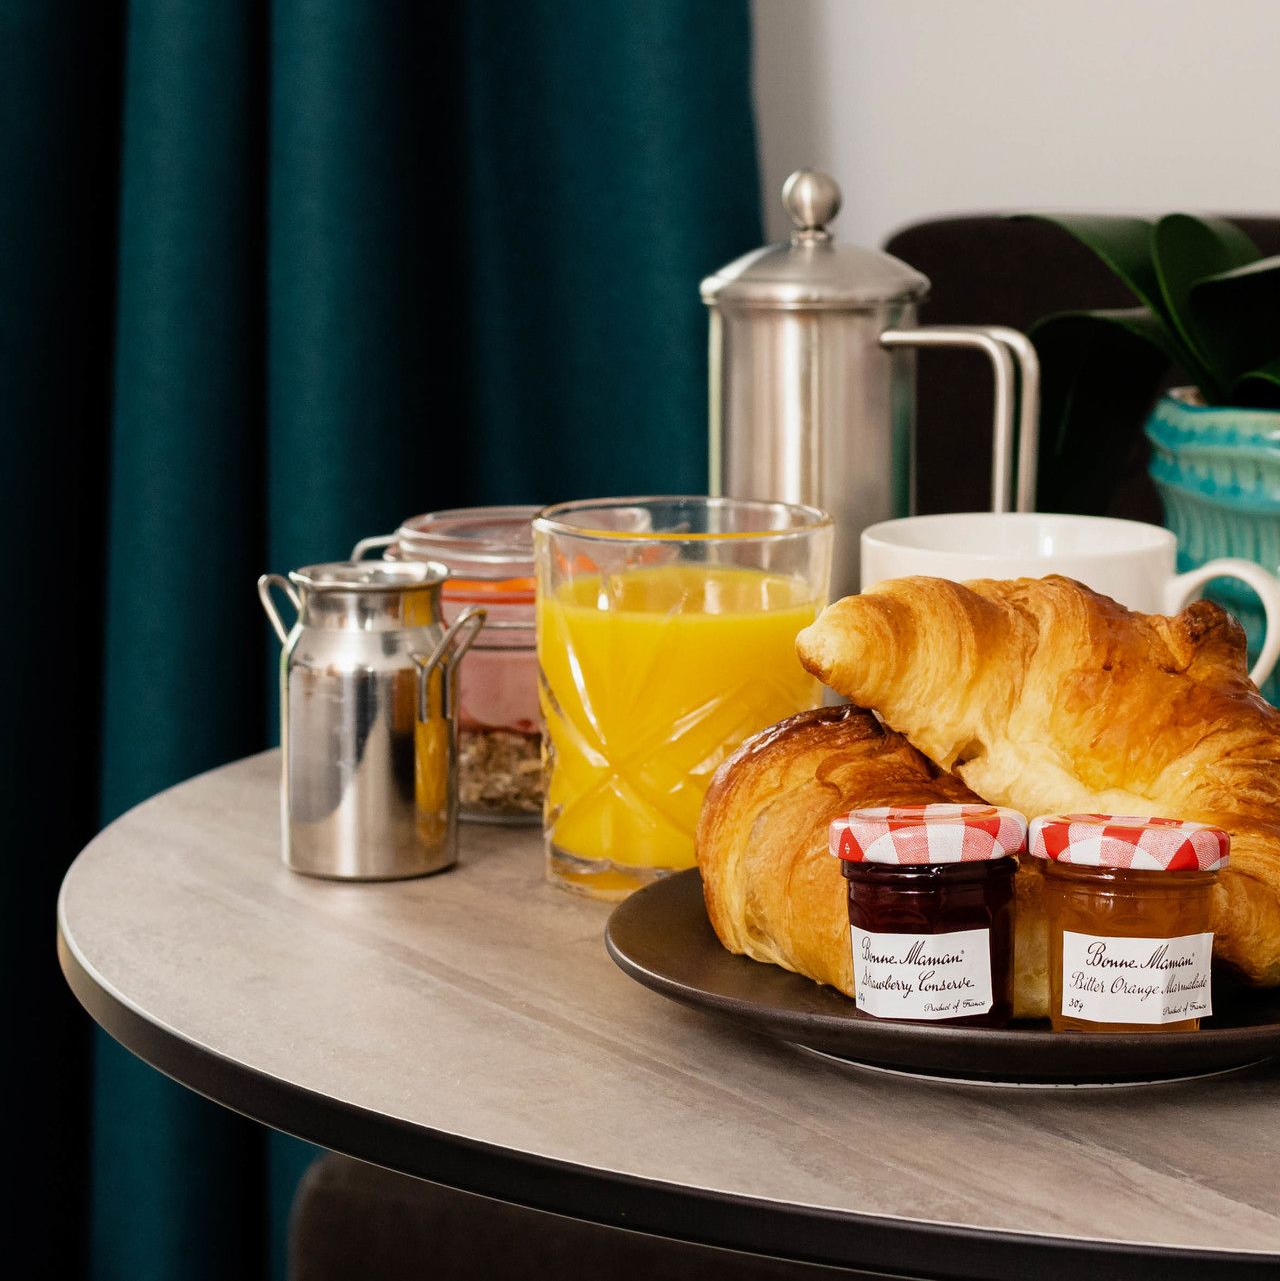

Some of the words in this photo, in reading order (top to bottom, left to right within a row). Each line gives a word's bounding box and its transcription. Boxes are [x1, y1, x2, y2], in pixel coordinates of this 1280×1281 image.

[1086, 941, 1138, 968] Bonne
[861, 966, 913, 999] Strawberry
[918, 970, 975, 992] Conserve
[1069, 971, 1106, 993] Bitter
[1110, 975, 1160, 1002] Orange
[1161, 973, 1208, 994] Marmalade
[923, 1002, 950, 1013] Product
[952, 999, 960, 1013] of
[962, 998, 986, 1009] France
[1068, 998, 1084, 1013] 30g
[1162, 1006, 1182, 1016] Product
[1182, 1002, 1189, 1016] of
[1189, 1001, 1208, 1011] France
